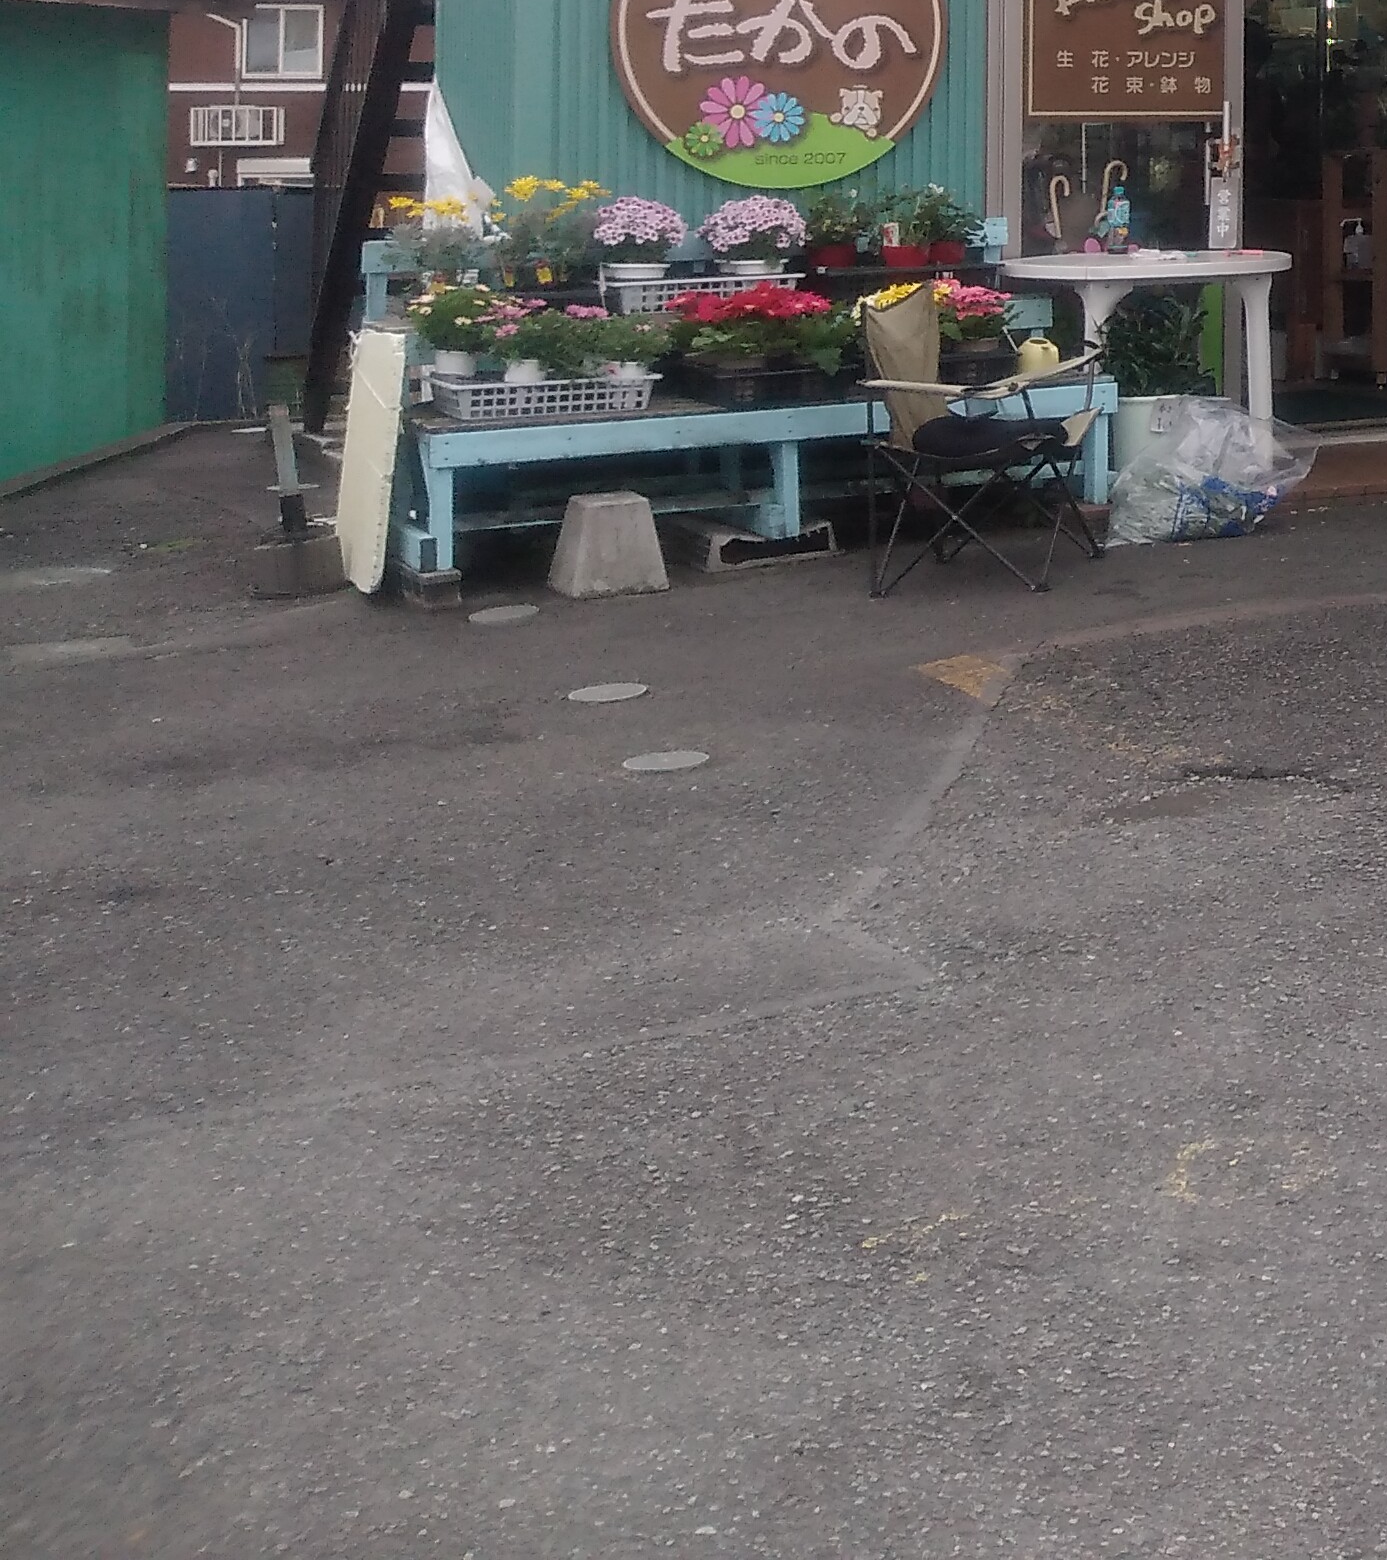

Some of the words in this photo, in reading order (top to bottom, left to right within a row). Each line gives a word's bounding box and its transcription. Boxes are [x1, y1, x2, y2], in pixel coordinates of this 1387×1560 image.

[1134, 0, 1216, 34] Shop
[755, 153, 798, 165] since
[804, 152, 847, 165] 2007
